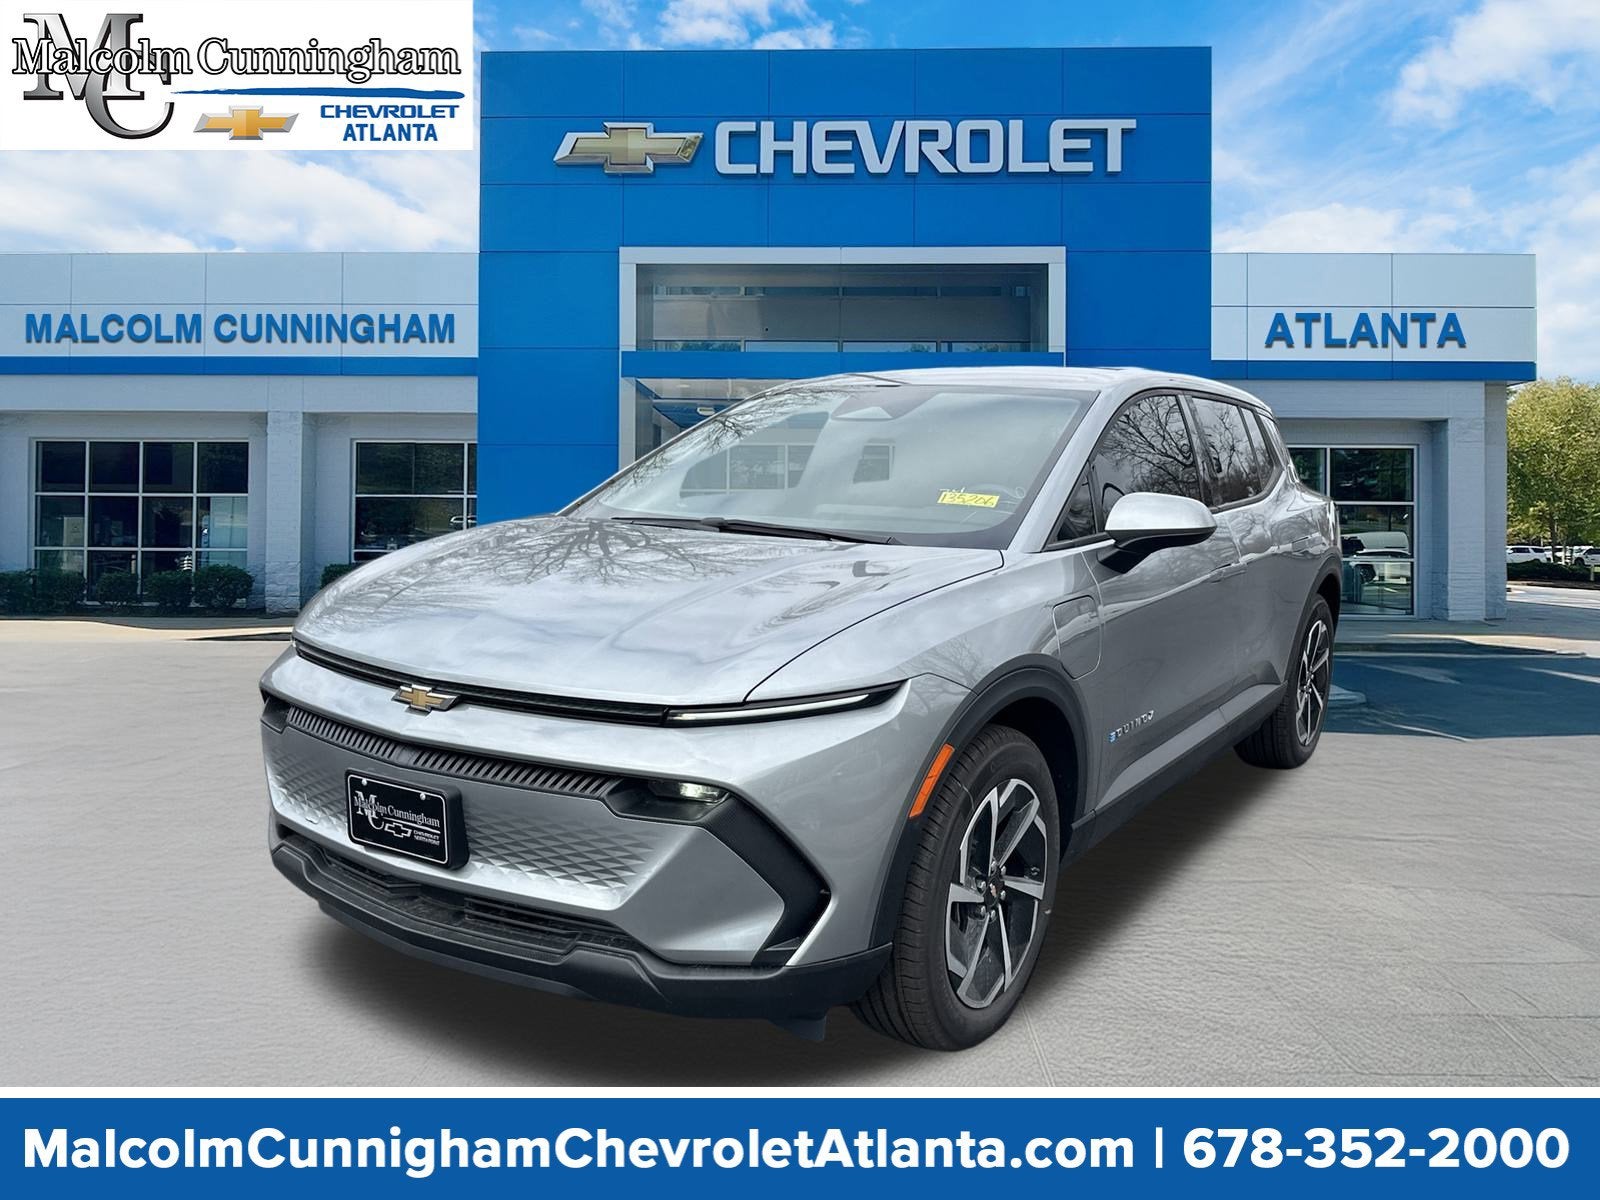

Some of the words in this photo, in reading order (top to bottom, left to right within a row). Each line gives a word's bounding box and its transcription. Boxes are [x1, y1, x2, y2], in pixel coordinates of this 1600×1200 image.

[715, 119, 1137, 176] CHEVROLET
[25, 313, 201, 343] MALCOLM
[213, 313, 455, 343] CUNNINGHAM
[1264, 312, 1467, 348] ATLANTA
[387, 804, 441, 827] Cunningham
